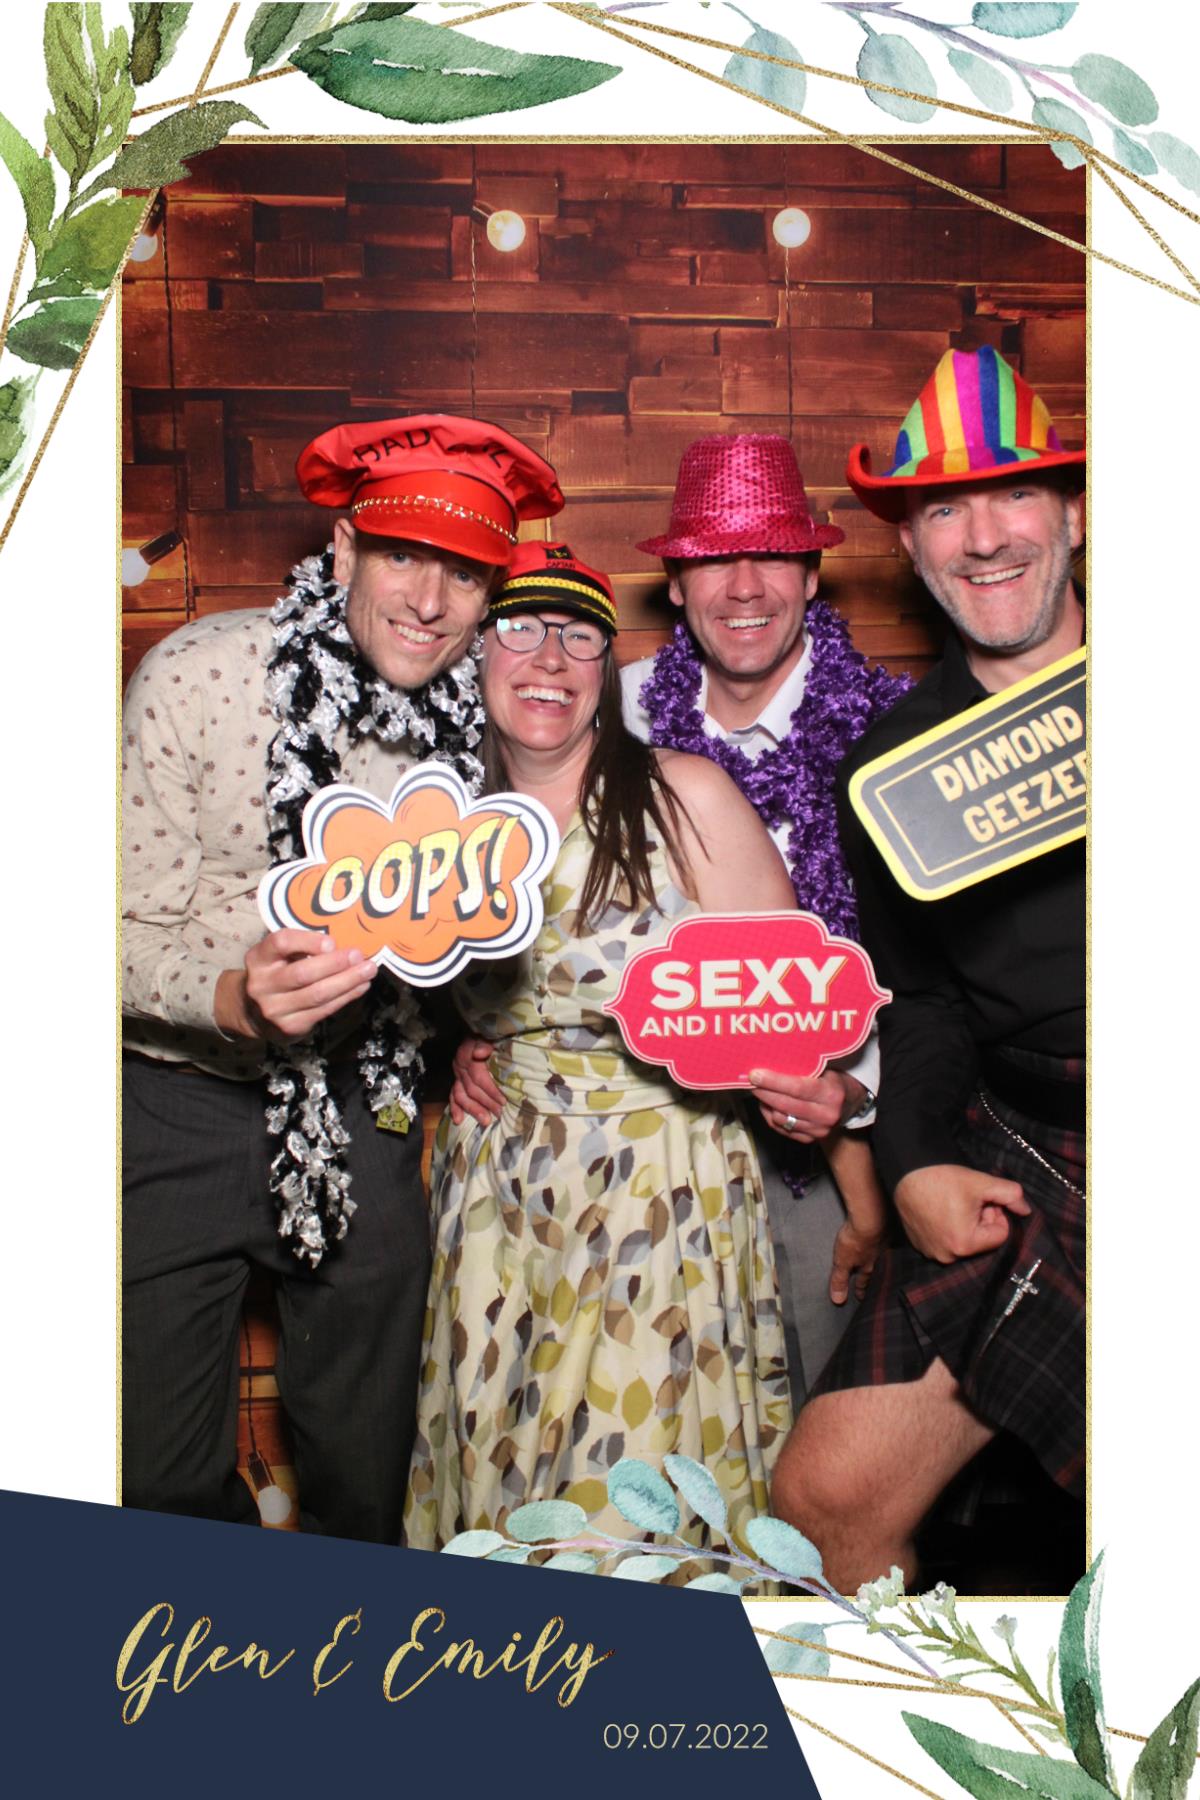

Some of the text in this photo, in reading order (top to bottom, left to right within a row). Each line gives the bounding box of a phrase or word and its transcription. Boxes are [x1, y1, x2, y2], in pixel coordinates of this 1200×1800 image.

[931, 705, 1083, 802] DIAMOND
[311, 814, 520, 921] OOPS!
[650, 956, 848, 1011] SEXY
[639, 1009, 859, 1038] AND I KNOW IT
